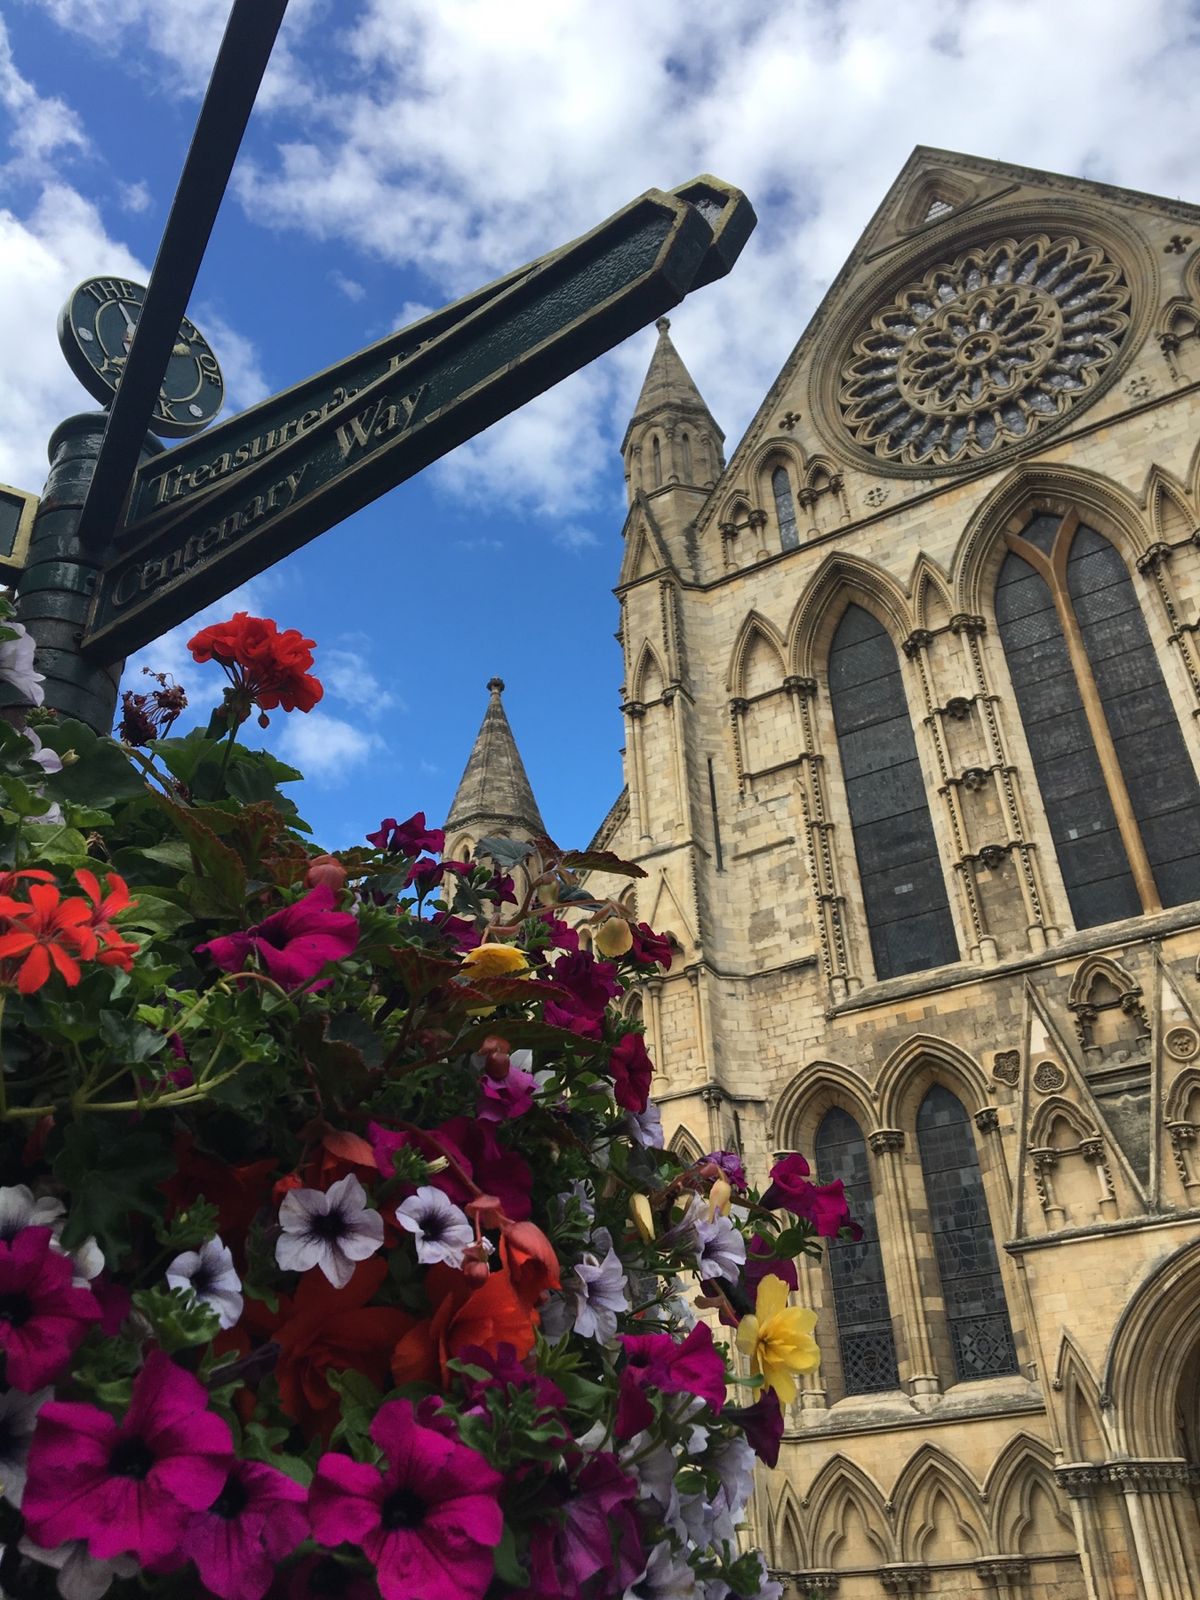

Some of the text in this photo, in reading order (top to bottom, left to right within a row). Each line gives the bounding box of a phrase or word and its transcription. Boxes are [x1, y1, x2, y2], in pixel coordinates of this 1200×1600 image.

[83, 278, 221, 386] THE OF
[112, 382, 428, 606] Centenary Way
